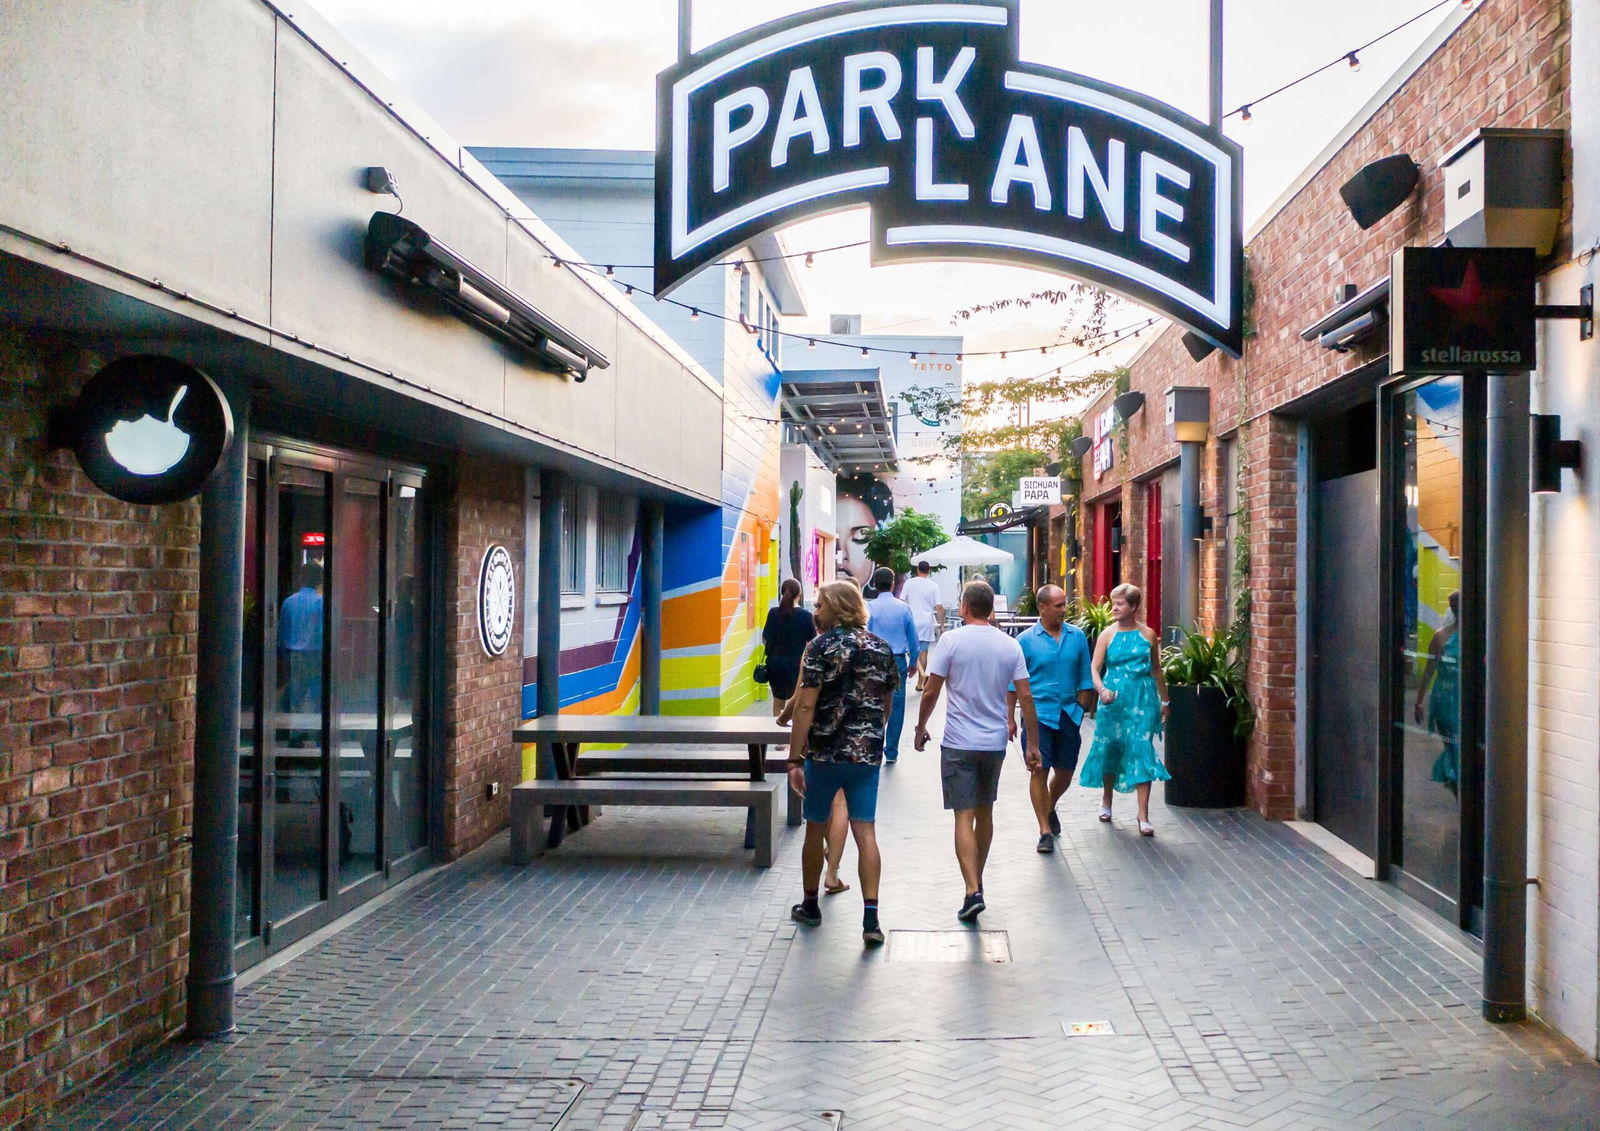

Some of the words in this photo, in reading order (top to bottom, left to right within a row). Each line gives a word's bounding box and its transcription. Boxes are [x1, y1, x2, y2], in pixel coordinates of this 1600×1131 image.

[713, 46, 976, 193] PARK
[915, 114, 1191, 263] LANE
[1420, 345, 1522, 364] stellarossa
[912, 363, 952, 371] TETTO
[1024, 480, 1058, 490] SICHUAN
[1024, 490, 1049, 500] PAPA
